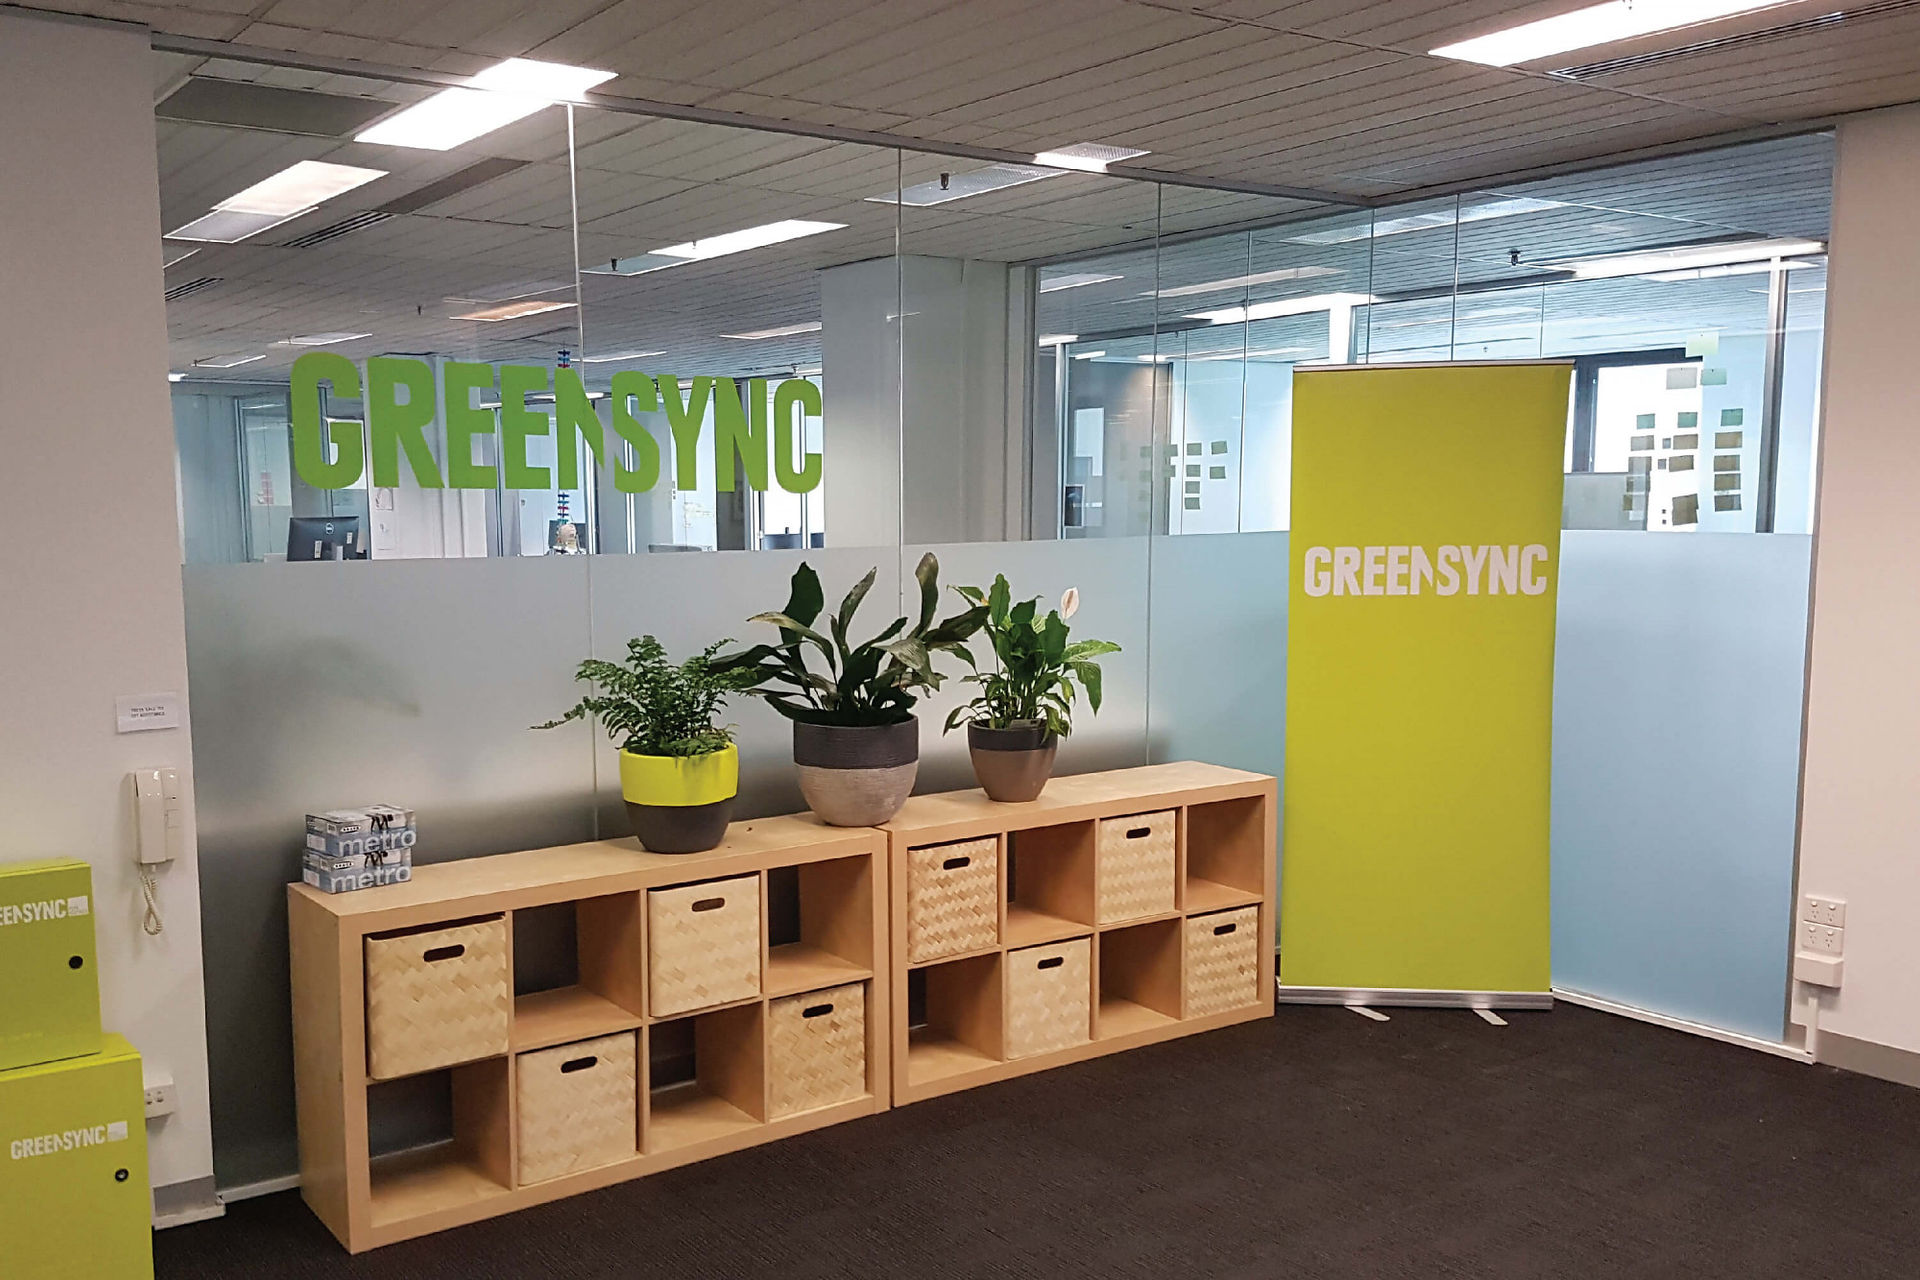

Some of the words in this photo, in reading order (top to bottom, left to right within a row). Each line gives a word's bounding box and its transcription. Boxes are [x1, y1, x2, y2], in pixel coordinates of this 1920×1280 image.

[290, 351, 823, 494] GREENSYNC
[1304, 544, 1548, 597] GREENSYNC
[339, 830, 416, 857] metro
[331, 866, 411, 893] metro
[11, 1125, 106, 1160] GREENSYNC
